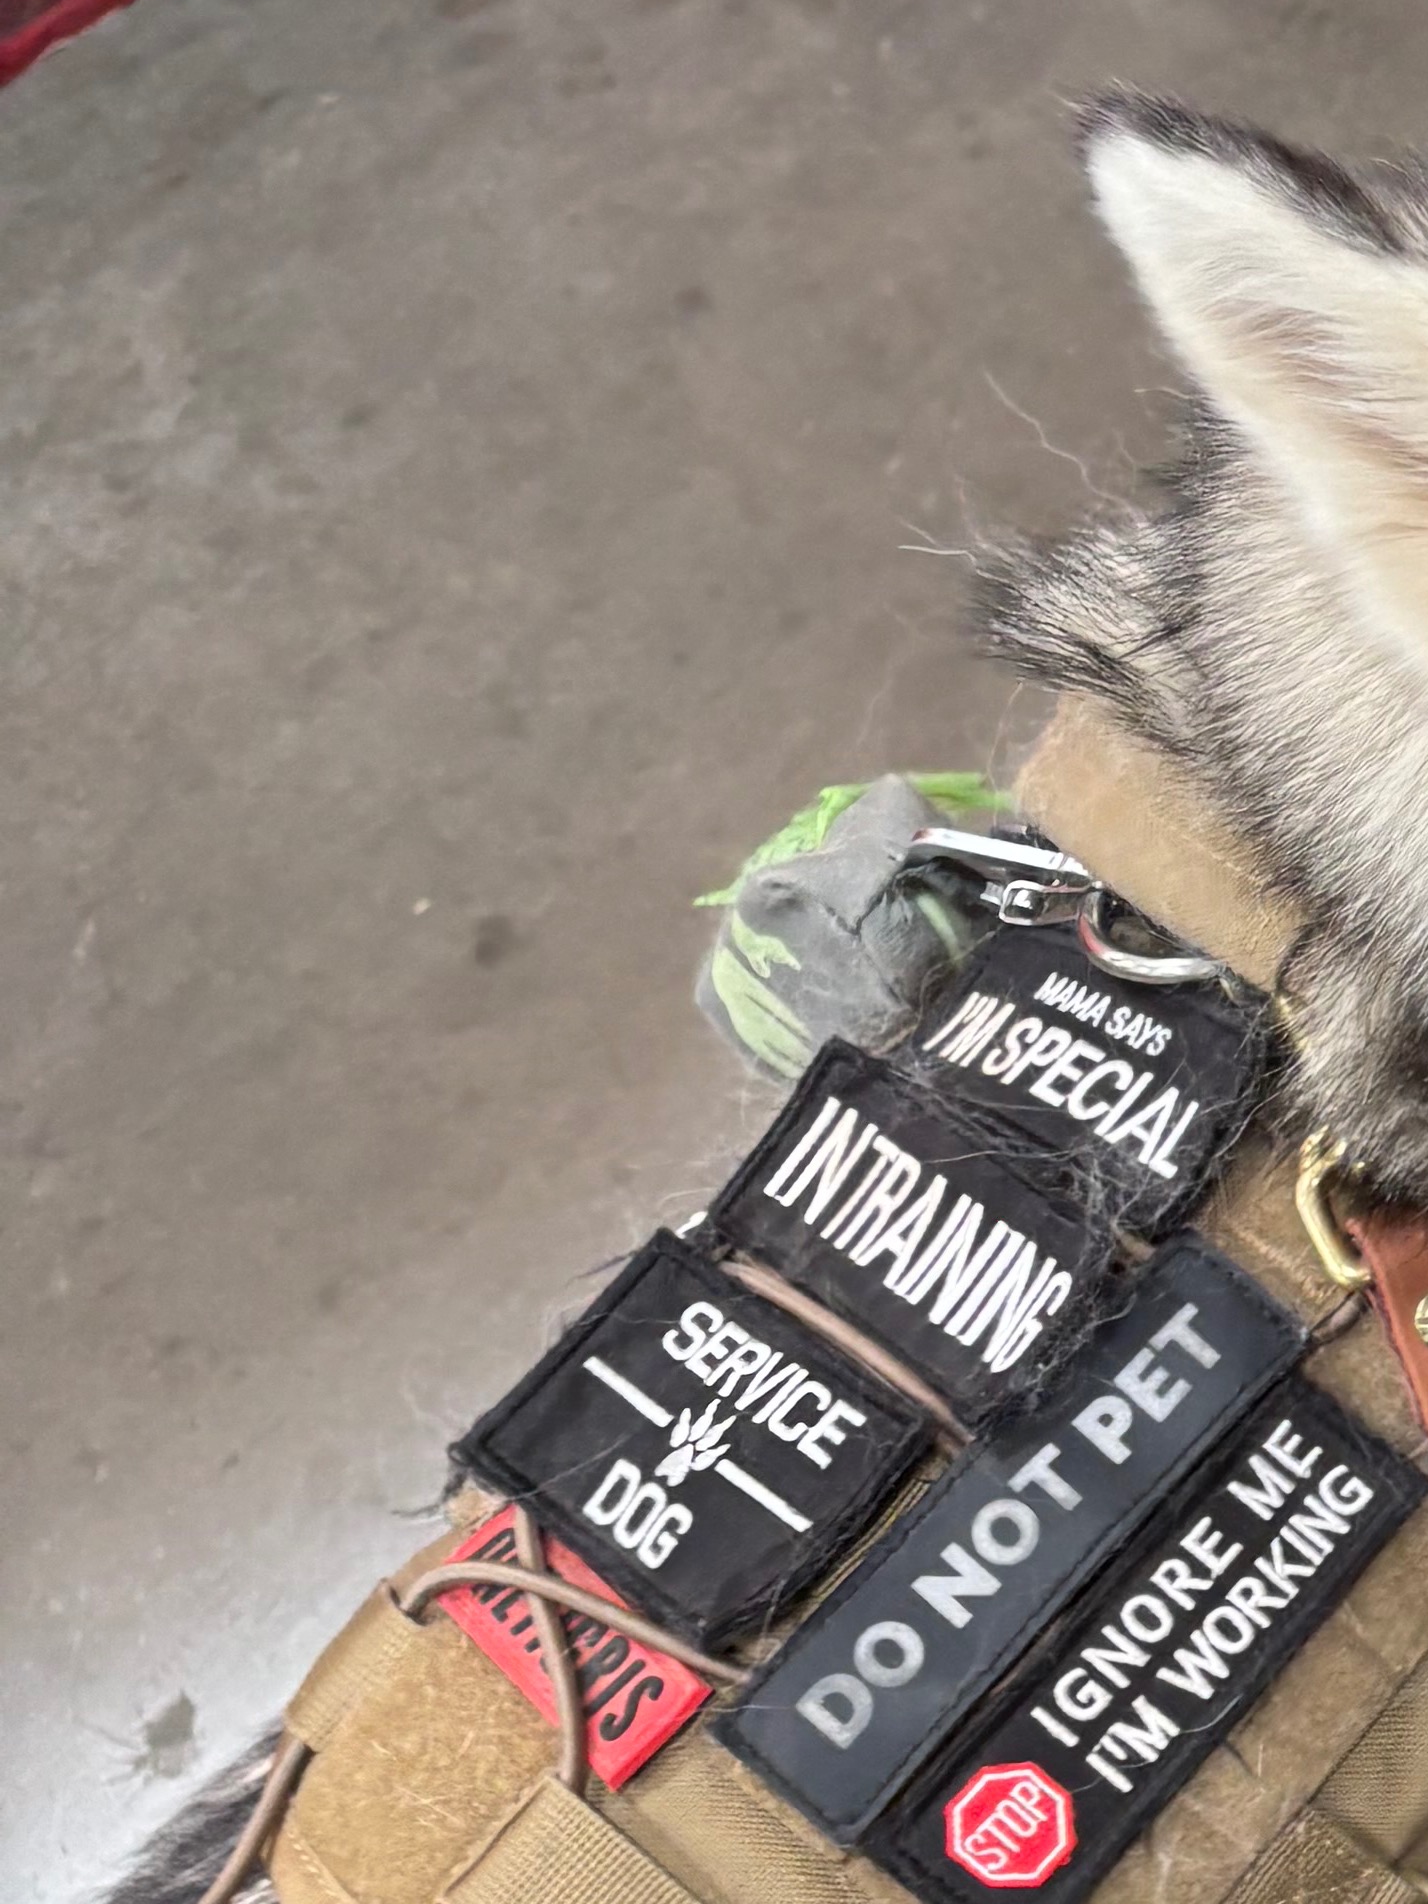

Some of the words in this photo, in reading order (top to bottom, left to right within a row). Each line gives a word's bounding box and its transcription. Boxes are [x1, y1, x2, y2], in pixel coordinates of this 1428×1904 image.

[922, 991, 1016, 1068] I'M
[982, 1017, 1200, 1179] SPECIAL
[1033, 971, 1112, 1028] MAMA
[1104, 1006, 1173, 1056] SAYS
[763, 1096, 879, 1225] IN
[820, 1135, 1073, 1374] TRAINING
[662, 1301, 867, 1470] SERVICE
[582, 1459, 694, 1570] DOG
[796, 1620, 925, 1750] DO
[910, 1442, 1083, 1629] NOT
[1071, 1302, 1222, 1465] PET
[1030, 1515, 1244, 1748] IGNORE
[1227, 1419, 1323, 1521] ME
[1085, 1695, 1181, 1794] I'M
[1156, 1464, 1375, 1700] WORKING
[964, 1780, 1048, 1872] STOP
